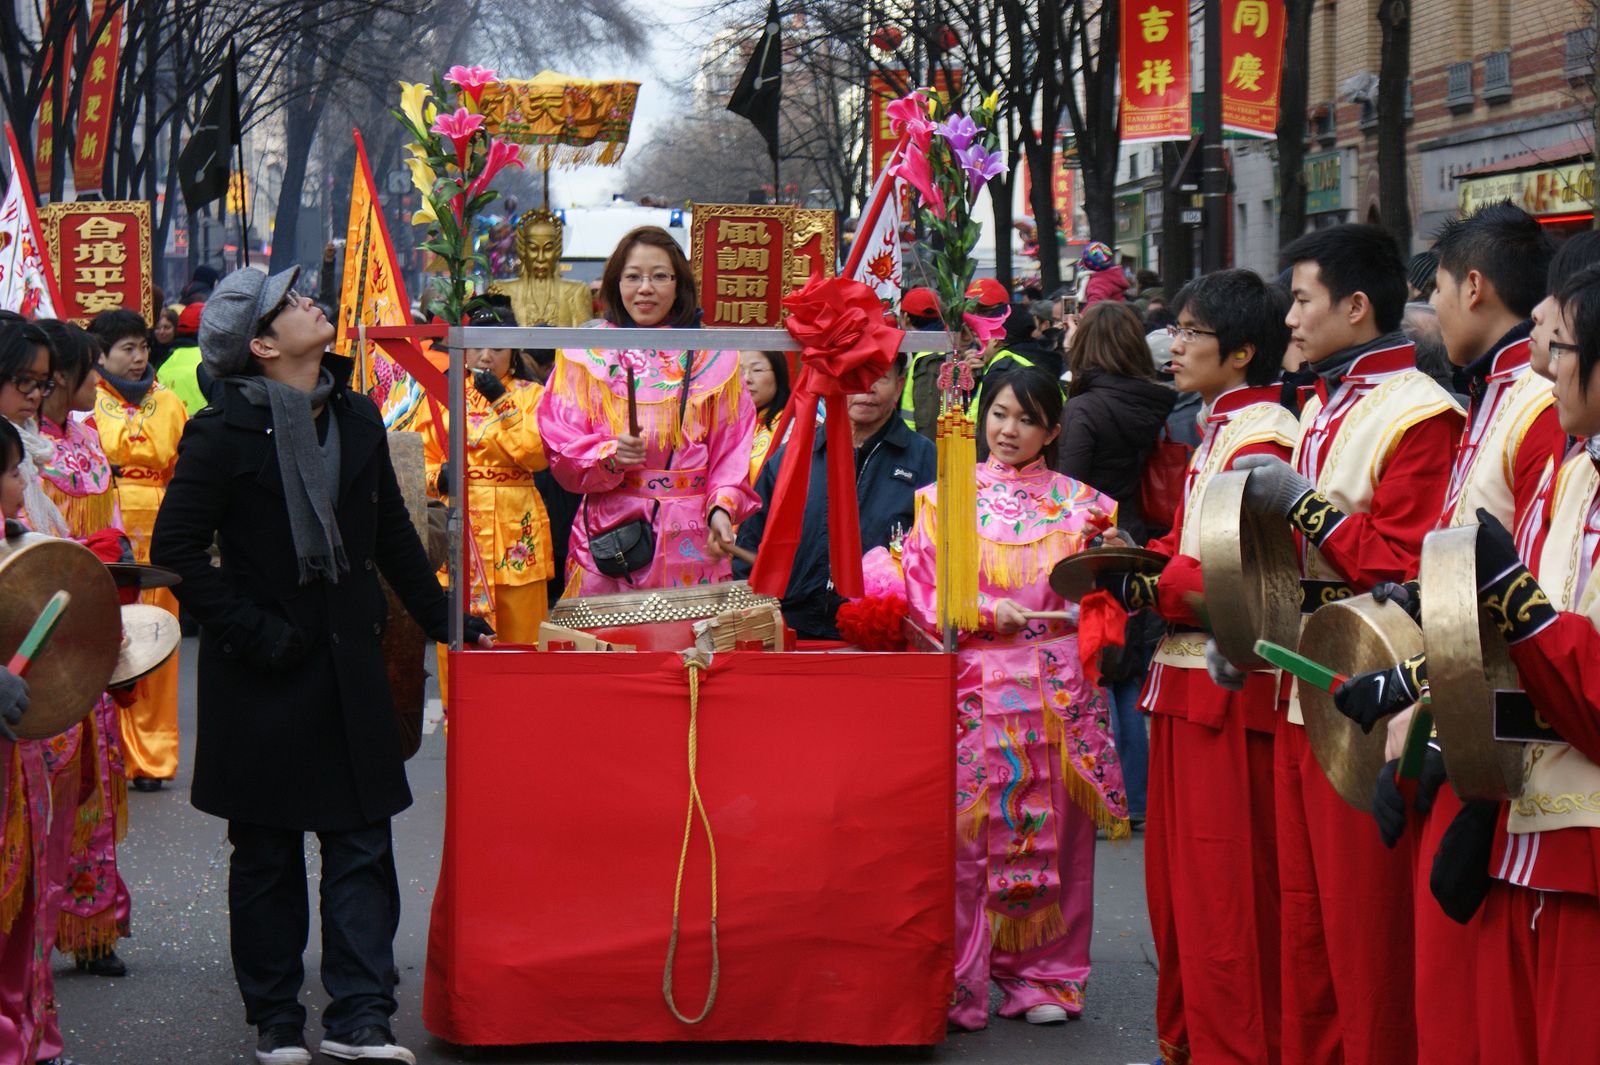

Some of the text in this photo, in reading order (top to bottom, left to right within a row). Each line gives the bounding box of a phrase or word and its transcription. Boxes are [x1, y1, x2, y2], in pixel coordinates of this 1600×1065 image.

[1137, 5, 1175, 97] 吉祥
[1228, 0, 1270, 92] 同慶
[73, 216, 127, 314] 合境平安
[714, 219, 772, 325] 風調雨順
